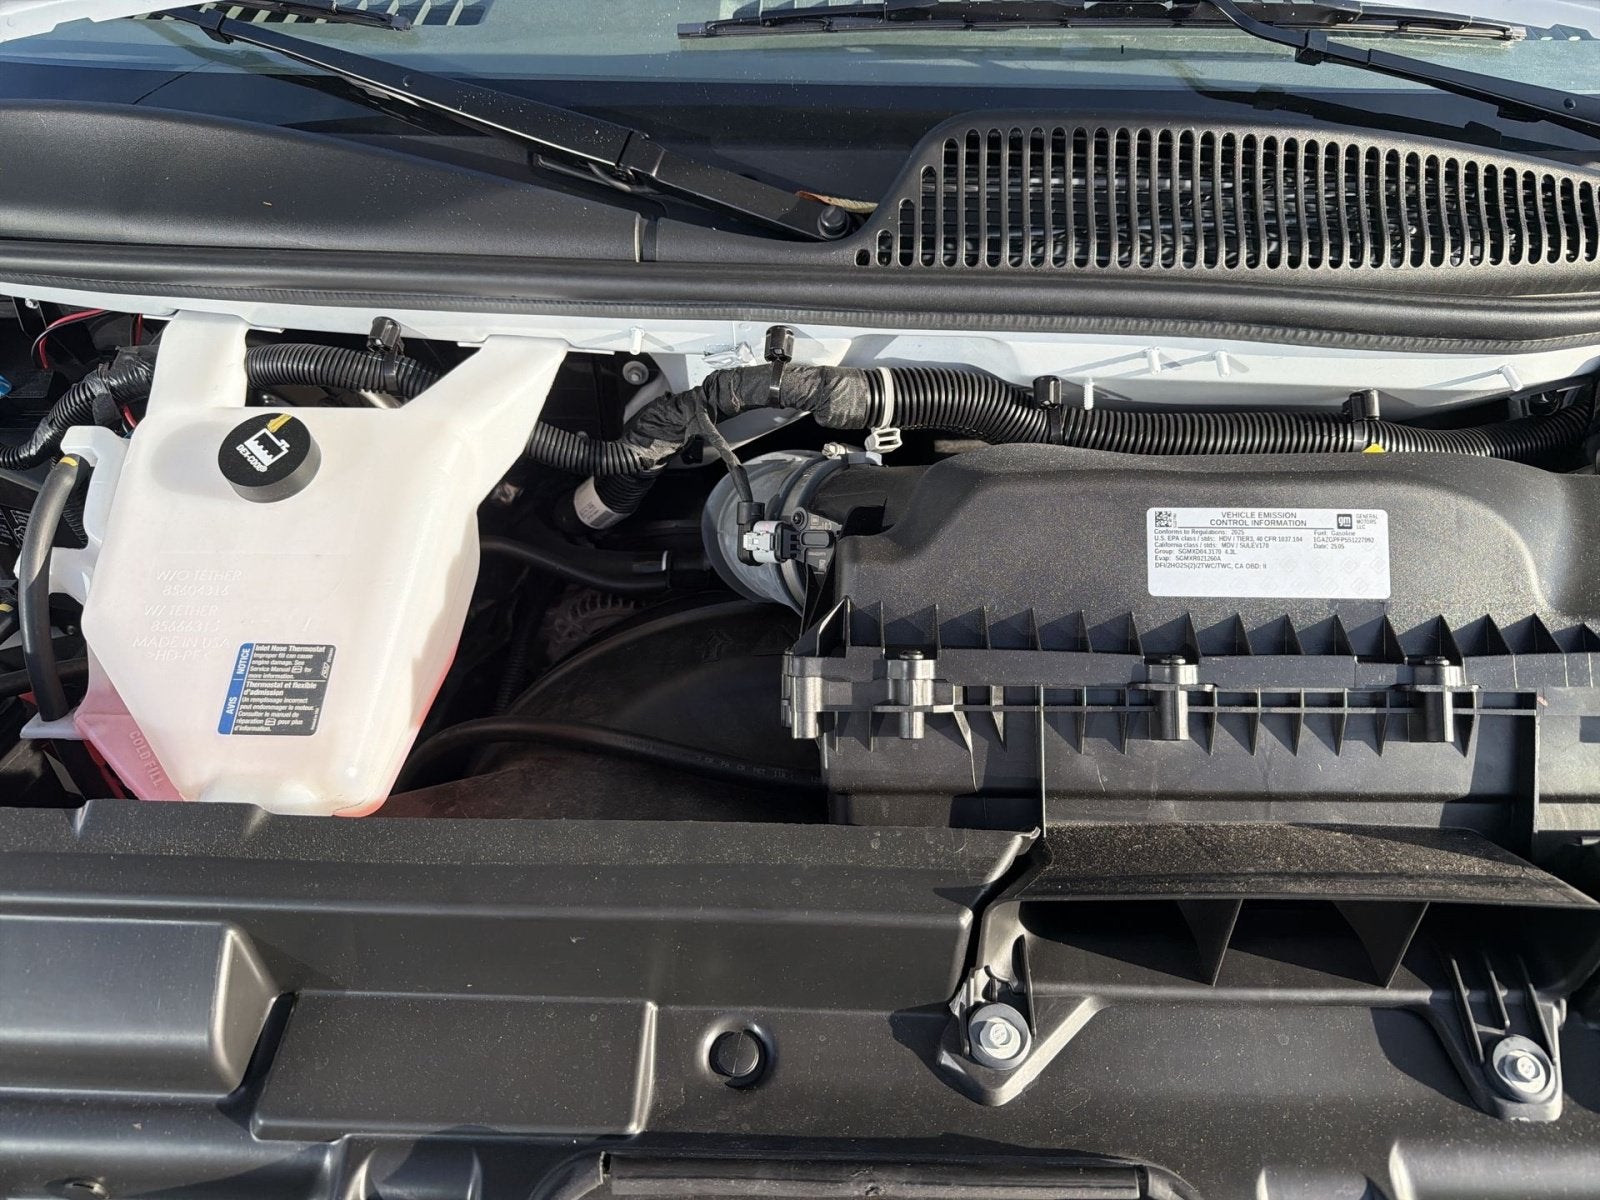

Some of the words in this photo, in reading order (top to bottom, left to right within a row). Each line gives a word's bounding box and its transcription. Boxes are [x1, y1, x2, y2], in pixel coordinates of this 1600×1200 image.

[1258, 511, 1297, 519] EMISSION
[1251, 519, 1307, 527] INFORMATION
[194, 570, 242, 581] TETHER
[168, 605, 218, 616] TETHER
[133, 636, 176, 648] MADE
[182, 637, 196, 648] IN
[202, 638, 231, 648] USA
[237, 648, 251, 675] NOTICE
[226, 697, 237, 714] AVIS
[129, 731, 150, 761] COLD
[145, 760, 164, 787] FILL
